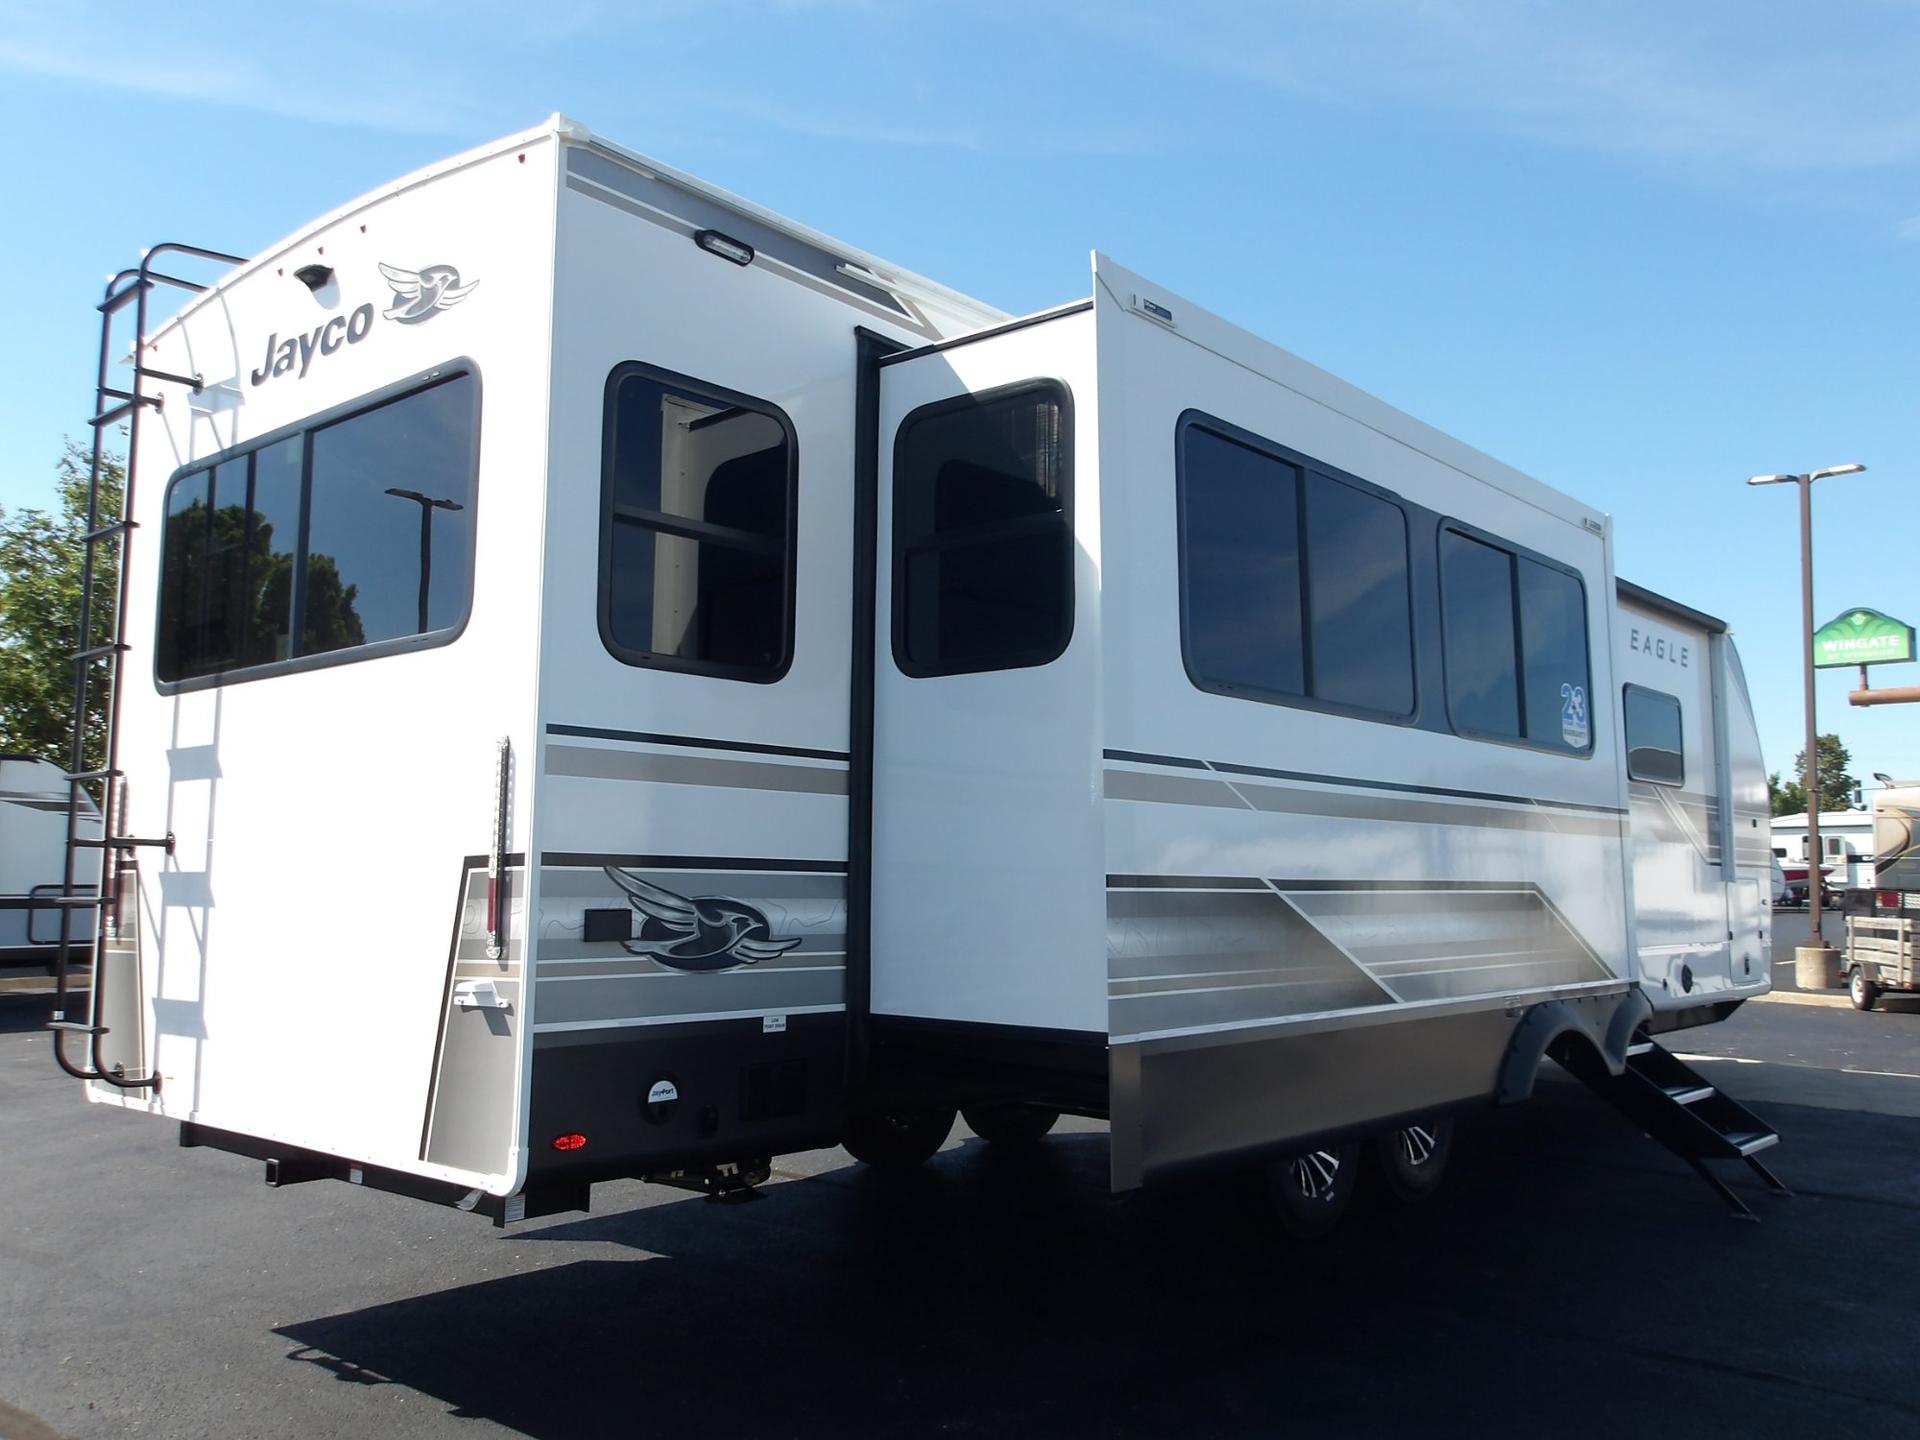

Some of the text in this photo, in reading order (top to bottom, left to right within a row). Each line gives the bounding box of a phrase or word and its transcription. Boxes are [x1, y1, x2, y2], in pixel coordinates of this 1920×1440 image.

[251, 302, 375, 387] Jayco
[1630, 627, 1689, 668] EAGLE
[1821, 634, 1900, 653] WINGATE
